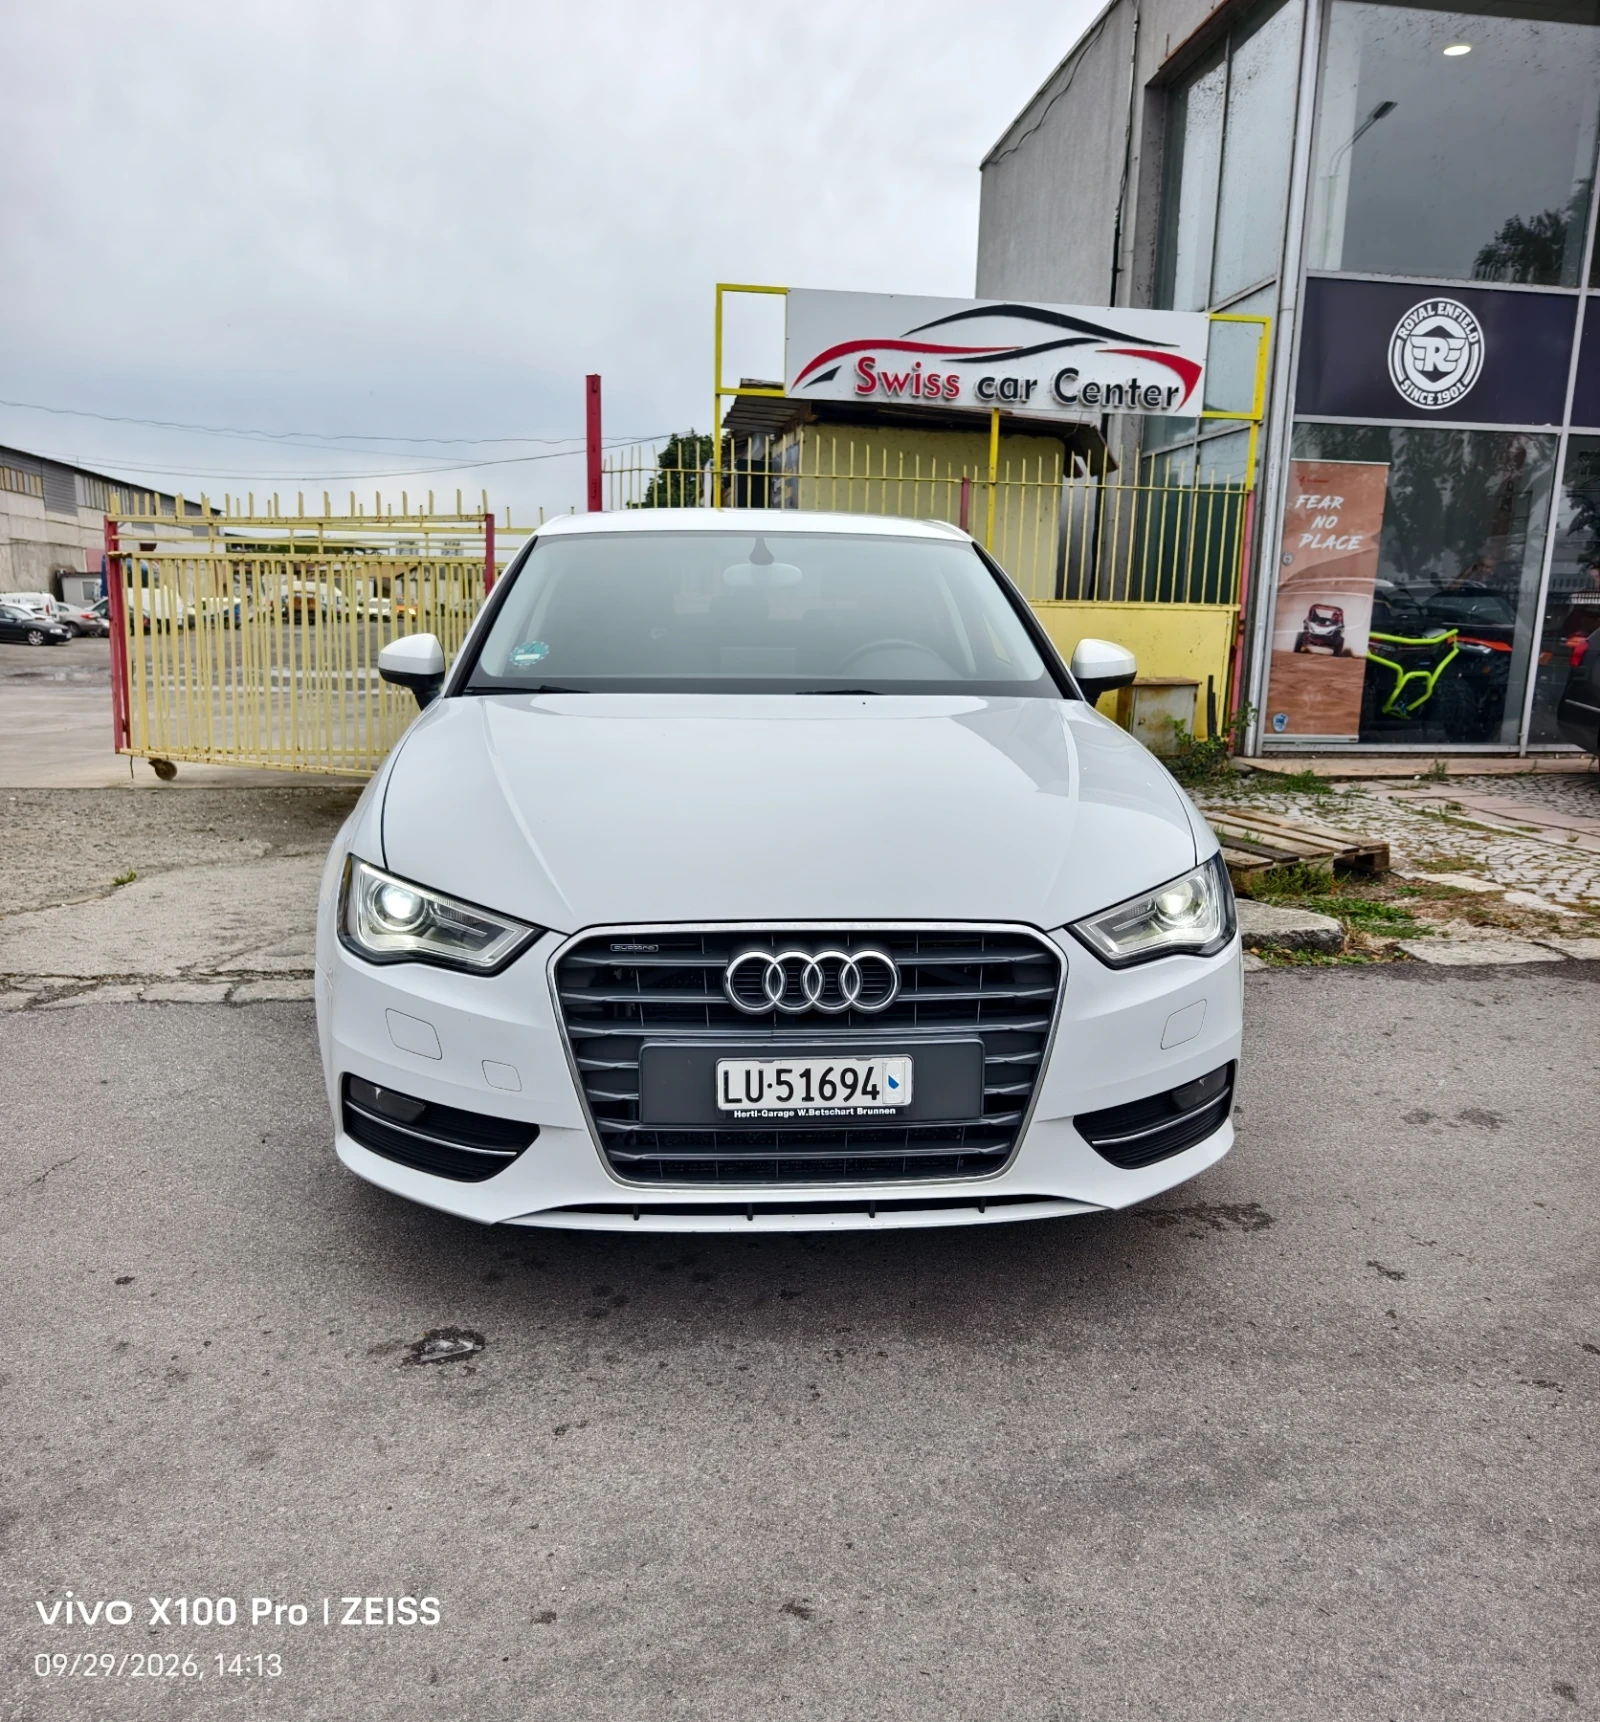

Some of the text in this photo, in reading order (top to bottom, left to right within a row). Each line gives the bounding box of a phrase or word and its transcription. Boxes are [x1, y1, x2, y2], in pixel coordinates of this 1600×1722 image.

[1397, 303, 1479, 343] ROYAL ENFIELD
[855, 356, 1181, 409] Swiss car Center
[1401, 379, 1466, 405] SINCE 1901
[1295, 494, 1344, 510] FEAR
[1311, 515, 1338, 530] NO
[1299, 533, 1363, 550] PLACE
[797, 1108, 854, 1116] W.Betschart
[857, 1107, 896, 1115] Brunnen
